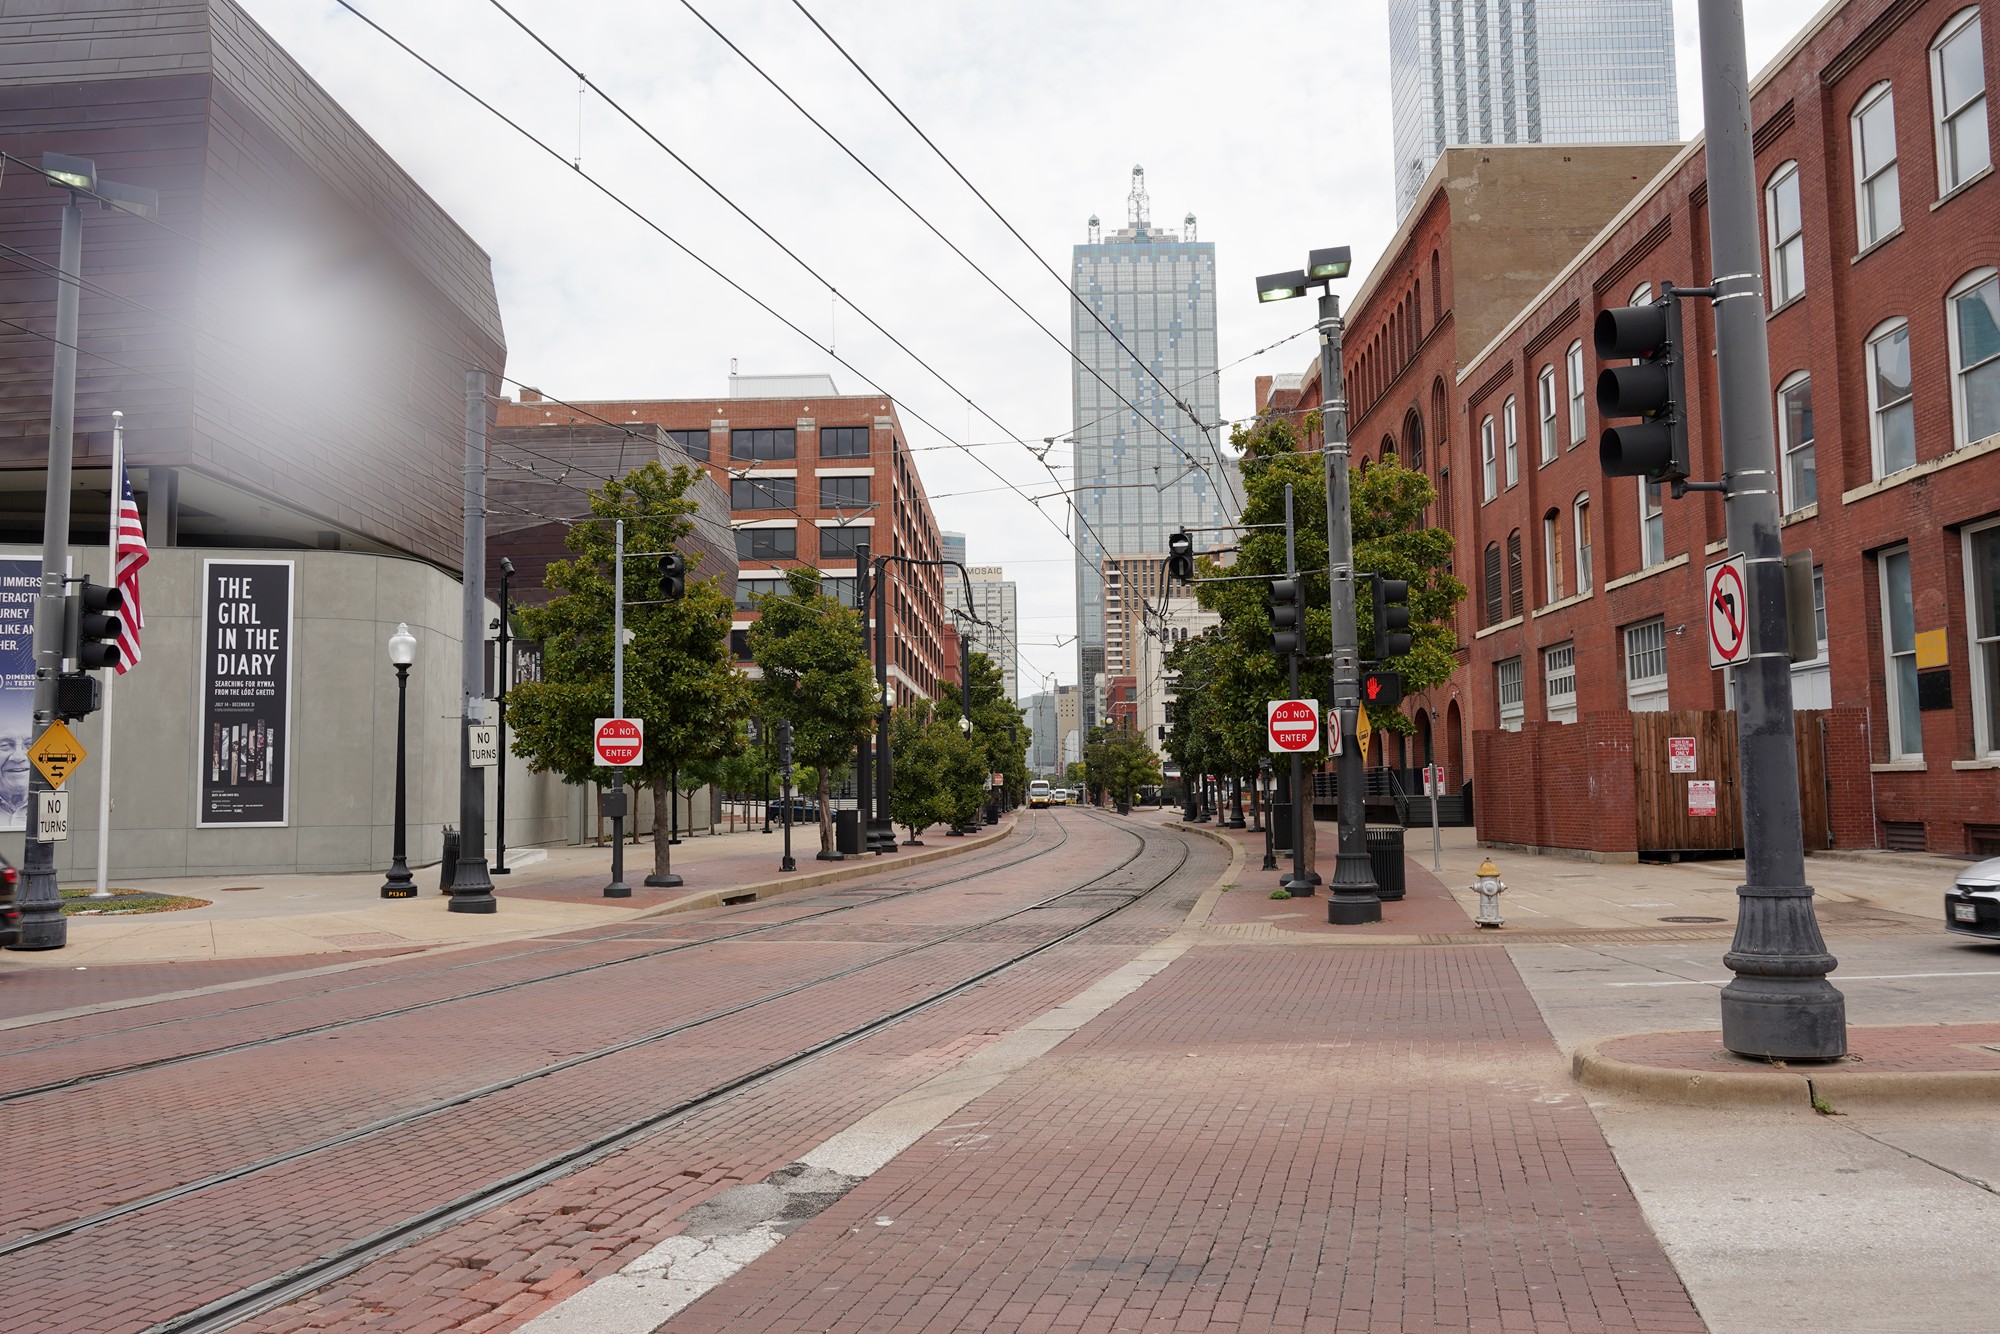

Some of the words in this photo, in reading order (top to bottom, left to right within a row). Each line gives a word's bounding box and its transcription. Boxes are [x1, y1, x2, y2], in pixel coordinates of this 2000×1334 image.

[966, 567, 1002, 575] MOSAIC
[218, 577, 252, 599] THE
[218, 602, 261, 624] GIRL
[218, 628, 237, 650] IN
[245, 628, 279, 650] THE
[217, 653, 276, 675] DIARY
[1276, 711, 1288, 719] DO
[1293, 710, 1310, 718] NOT
[602, 727, 615, 735] DO
[619, 727, 636, 735] NOT
[477, 732, 490, 744] NO
[1280, 733, 1307, 742] ENTER
[471, 749, 497, 759] TURNS
[605, 749, 632, 757] ENTER
[47, 799, 61, 813] NO
[40, 820, 67, 833] TURNS
